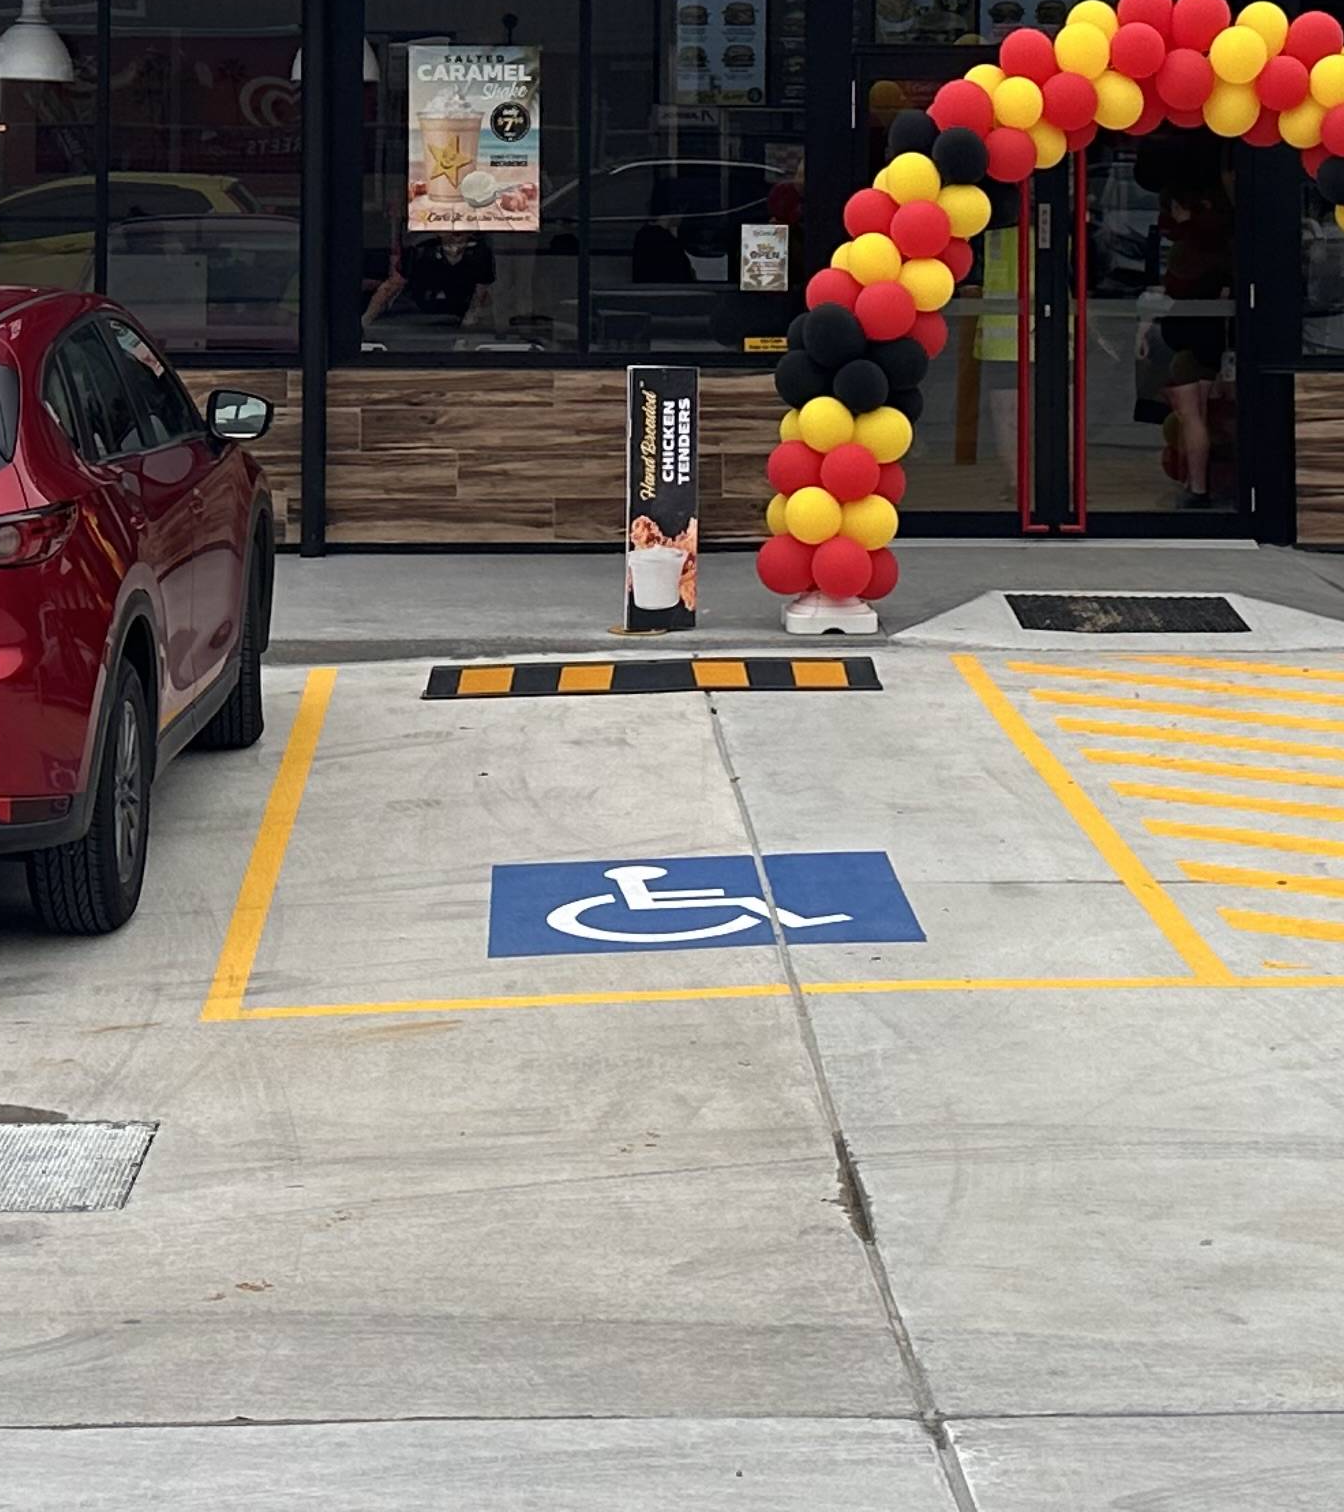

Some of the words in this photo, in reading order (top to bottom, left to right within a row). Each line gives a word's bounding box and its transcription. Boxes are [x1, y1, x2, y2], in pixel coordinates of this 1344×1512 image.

[416, 64, 532, 81] CARAMEL
[443, 54, 505, 64] SALTED
[482, 82, 528, 101] Shake
[640, 389, 657, 456] Breaded
[662, 400, 675, 483] CHICKEN
[678, 397, 691, 485] TENDERS
[640, 455, 657, 501] Hand
